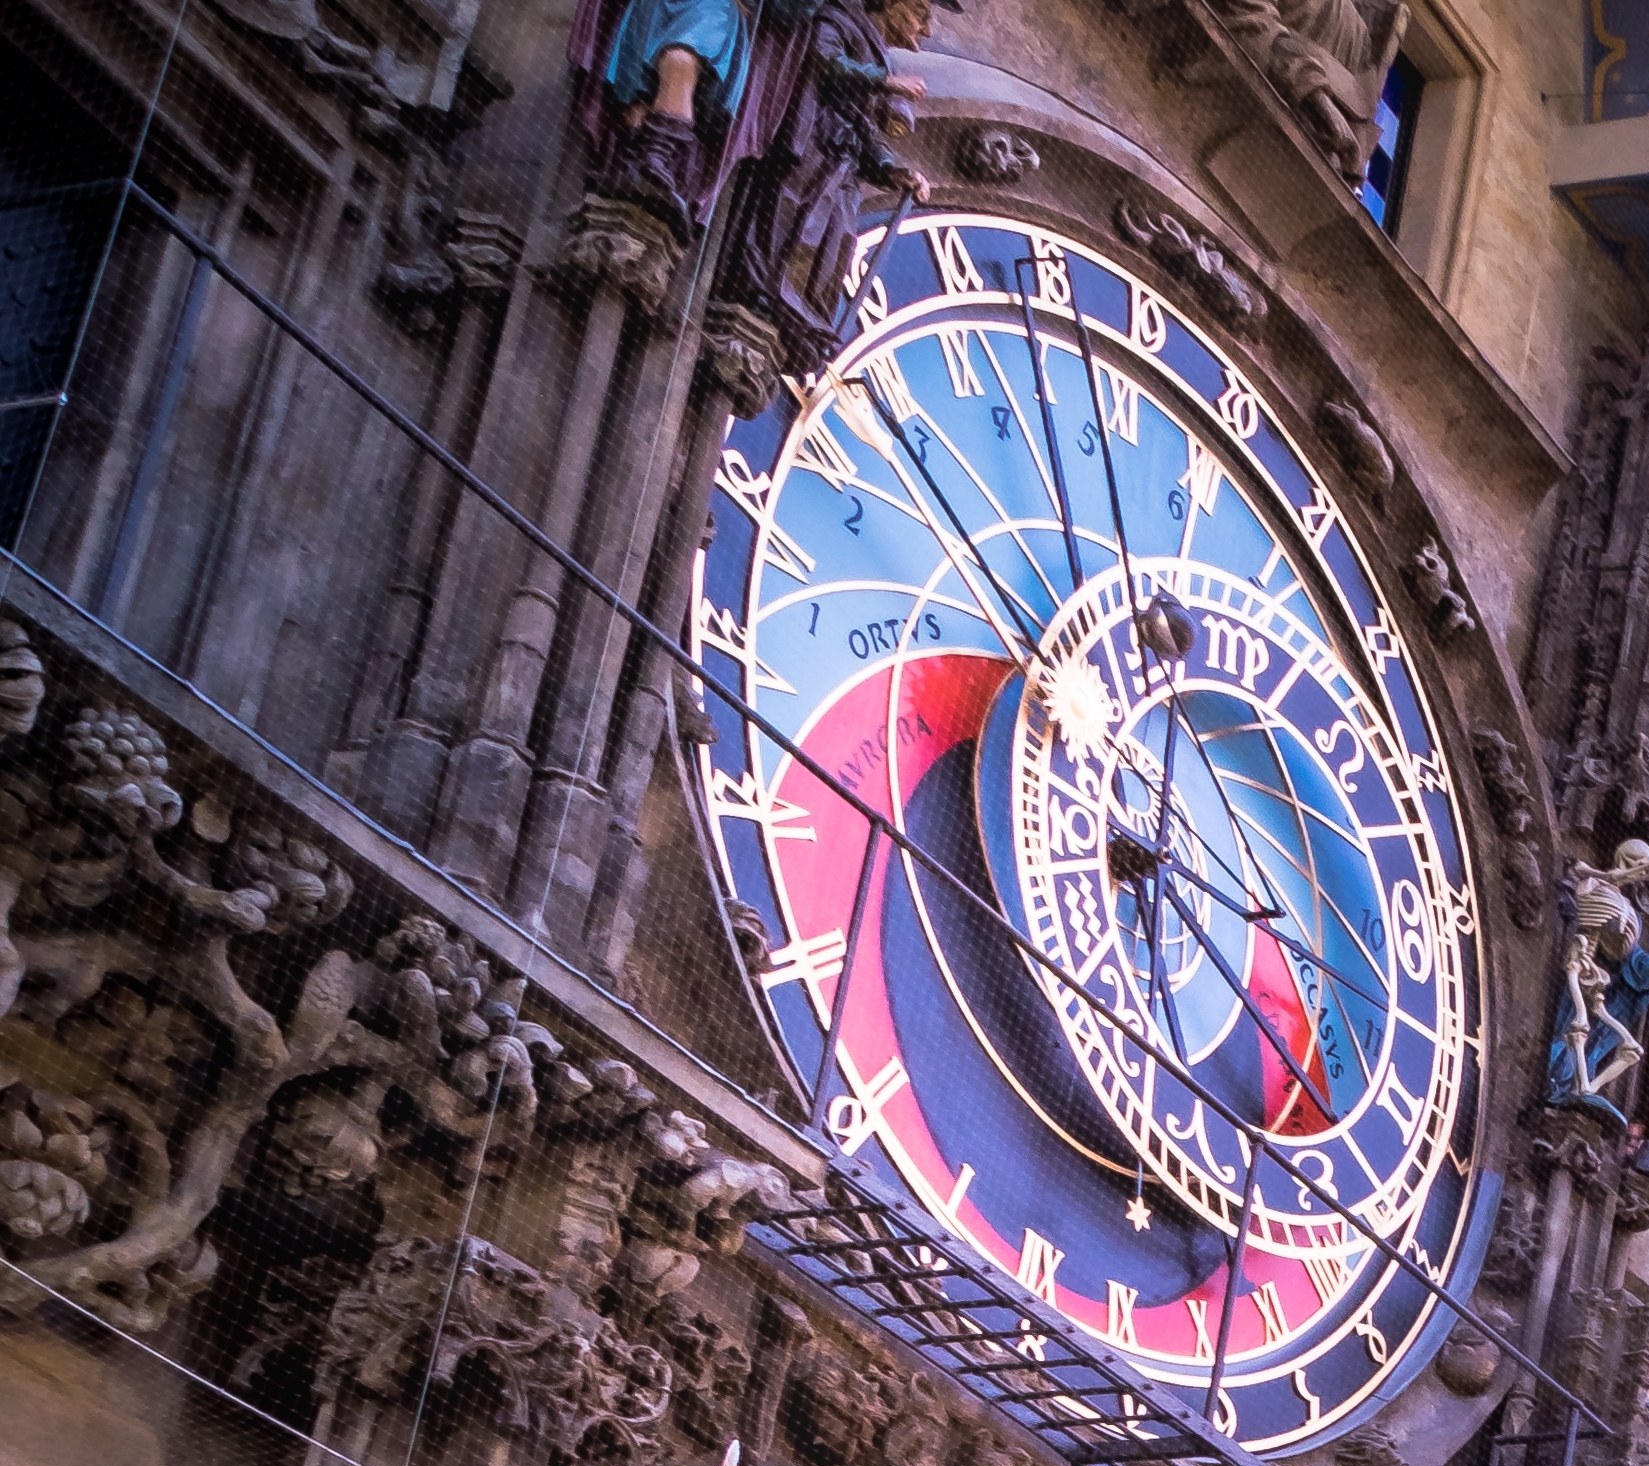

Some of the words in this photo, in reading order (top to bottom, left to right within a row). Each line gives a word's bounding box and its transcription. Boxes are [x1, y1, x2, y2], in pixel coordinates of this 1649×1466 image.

[844, 496, 864, 536] 2
[1168, 490, 1184, 520] 6
[809, 602, 820, 637] 1
[1361, 908, 1386, 952] 10
